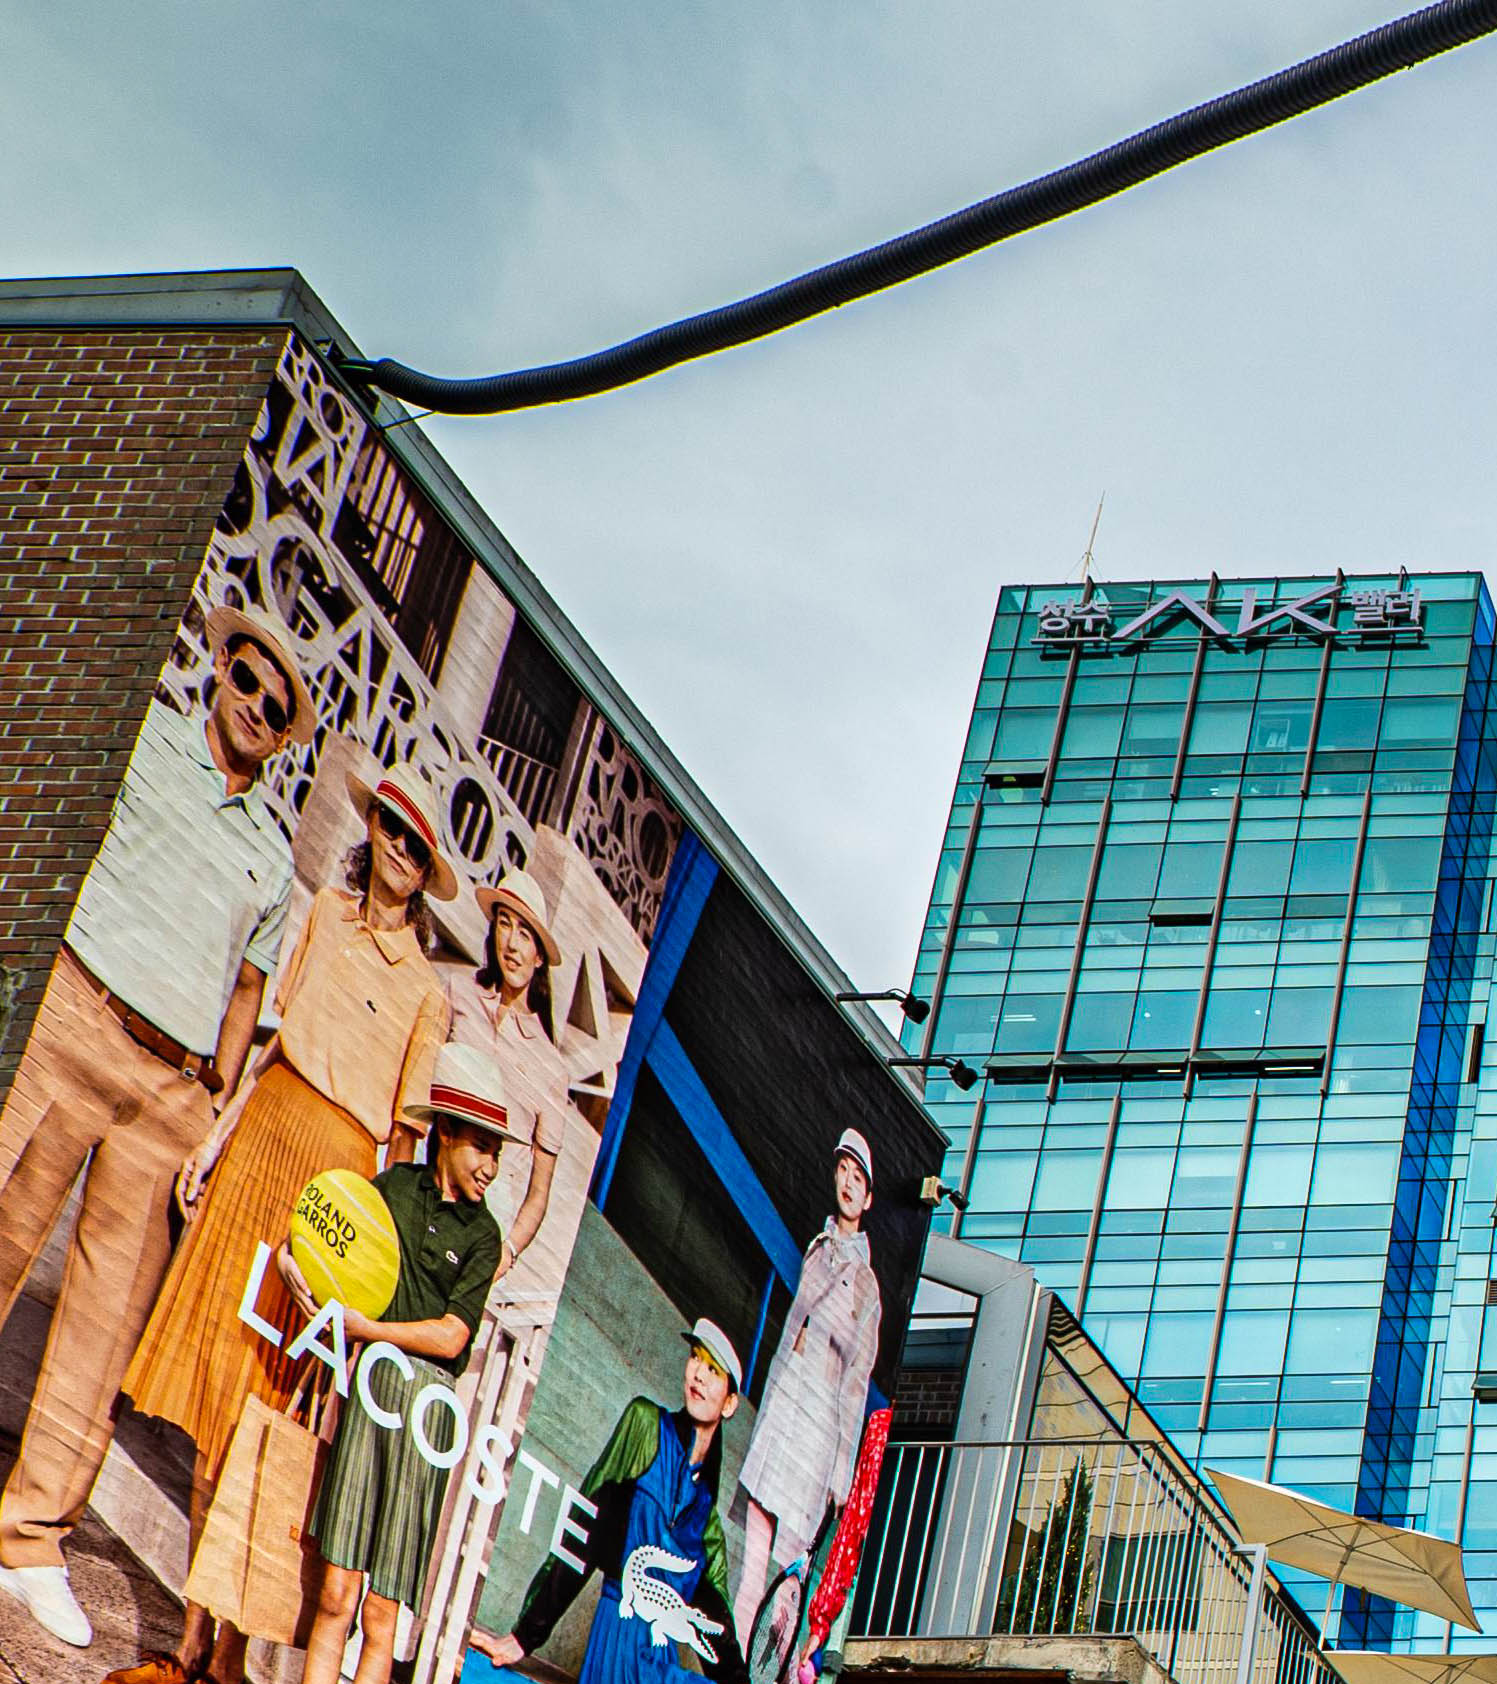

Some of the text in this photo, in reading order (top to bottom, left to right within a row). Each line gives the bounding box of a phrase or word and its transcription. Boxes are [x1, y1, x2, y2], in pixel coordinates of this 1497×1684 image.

[1039, 585, 1421, 639] 성수 AK 밸리
[238, 1240, 598, 1575] LACOSTE
